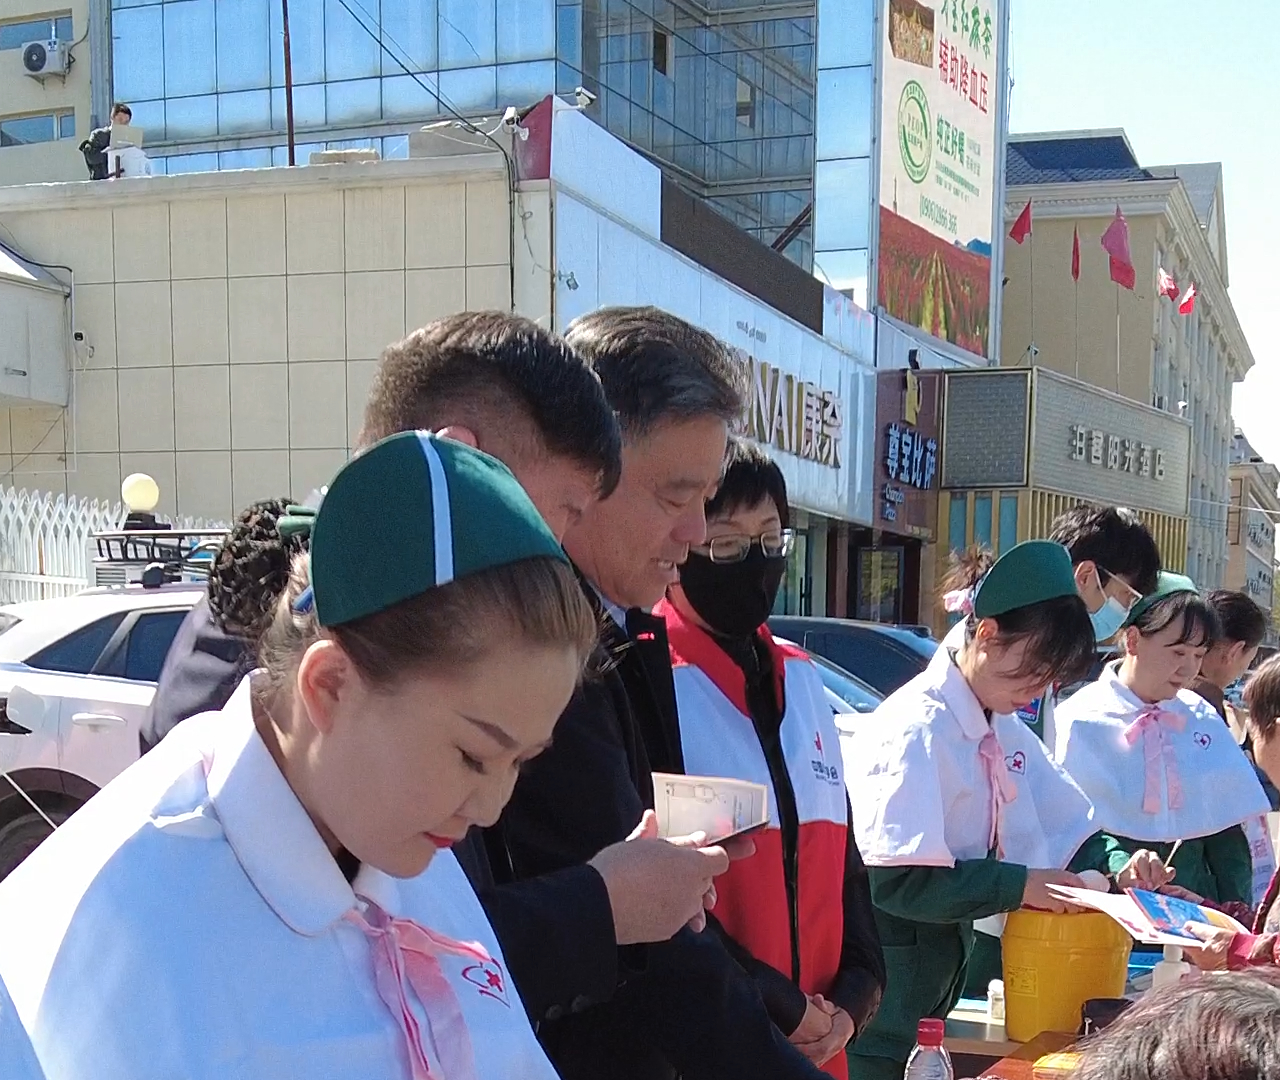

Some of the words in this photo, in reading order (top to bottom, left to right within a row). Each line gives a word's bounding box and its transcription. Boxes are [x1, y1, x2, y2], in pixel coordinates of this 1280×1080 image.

[939, 33, 989, 114] 辅助降血压
[887, 422, 937, 490] 尊宝比萨
